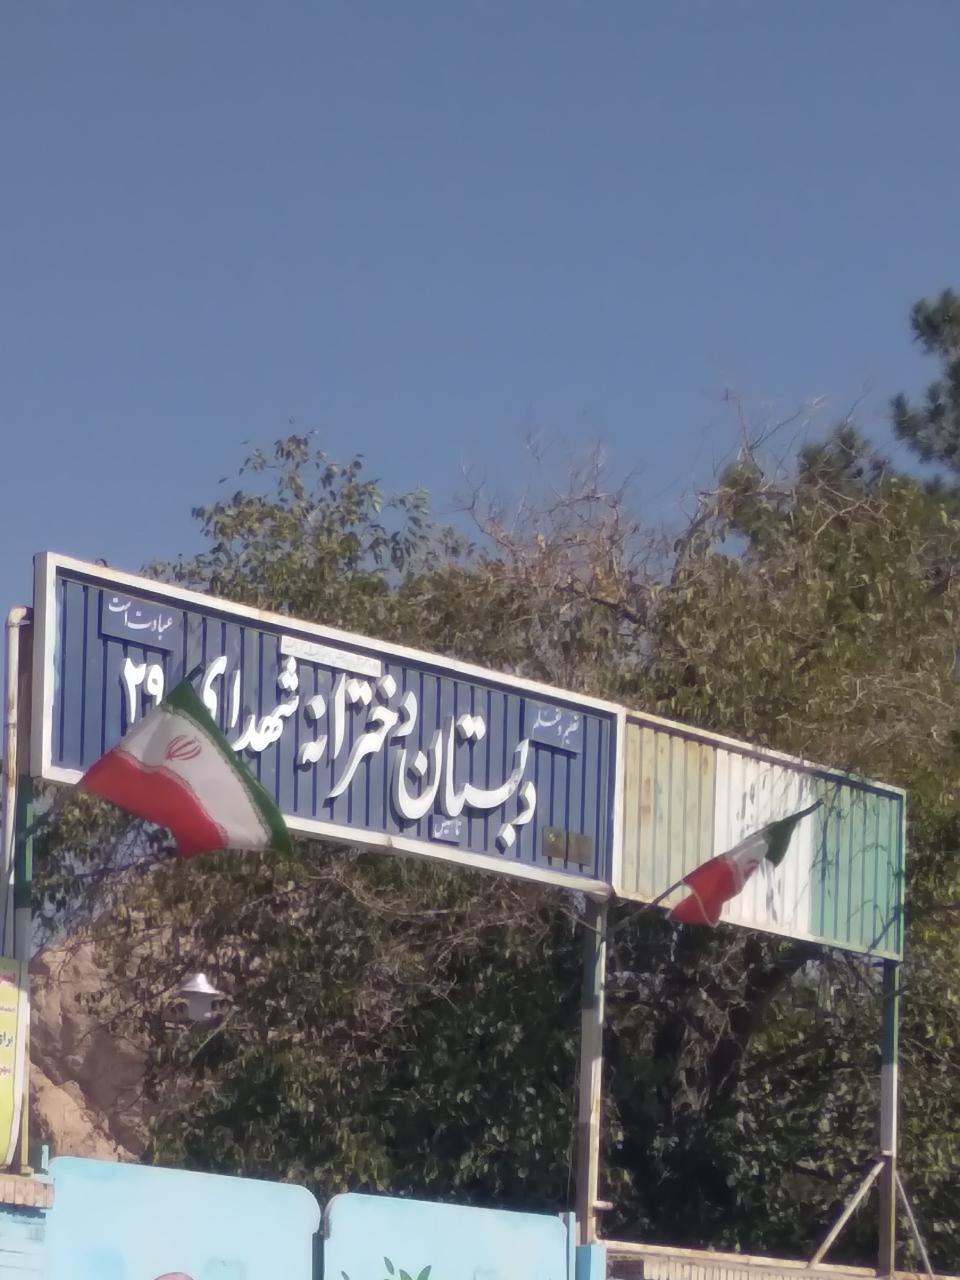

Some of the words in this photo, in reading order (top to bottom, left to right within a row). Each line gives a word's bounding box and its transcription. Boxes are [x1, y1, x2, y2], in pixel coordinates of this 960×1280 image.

[108, 597, 132, 626] است
[127, 610, 173, 641] عبادت
[120, 657, 165, 724] ۲۹
[201, 654, 300, 753] شهدای
[297, 673, 418, 799] دخترانه
[395, 714, 538, 849] دبستان
